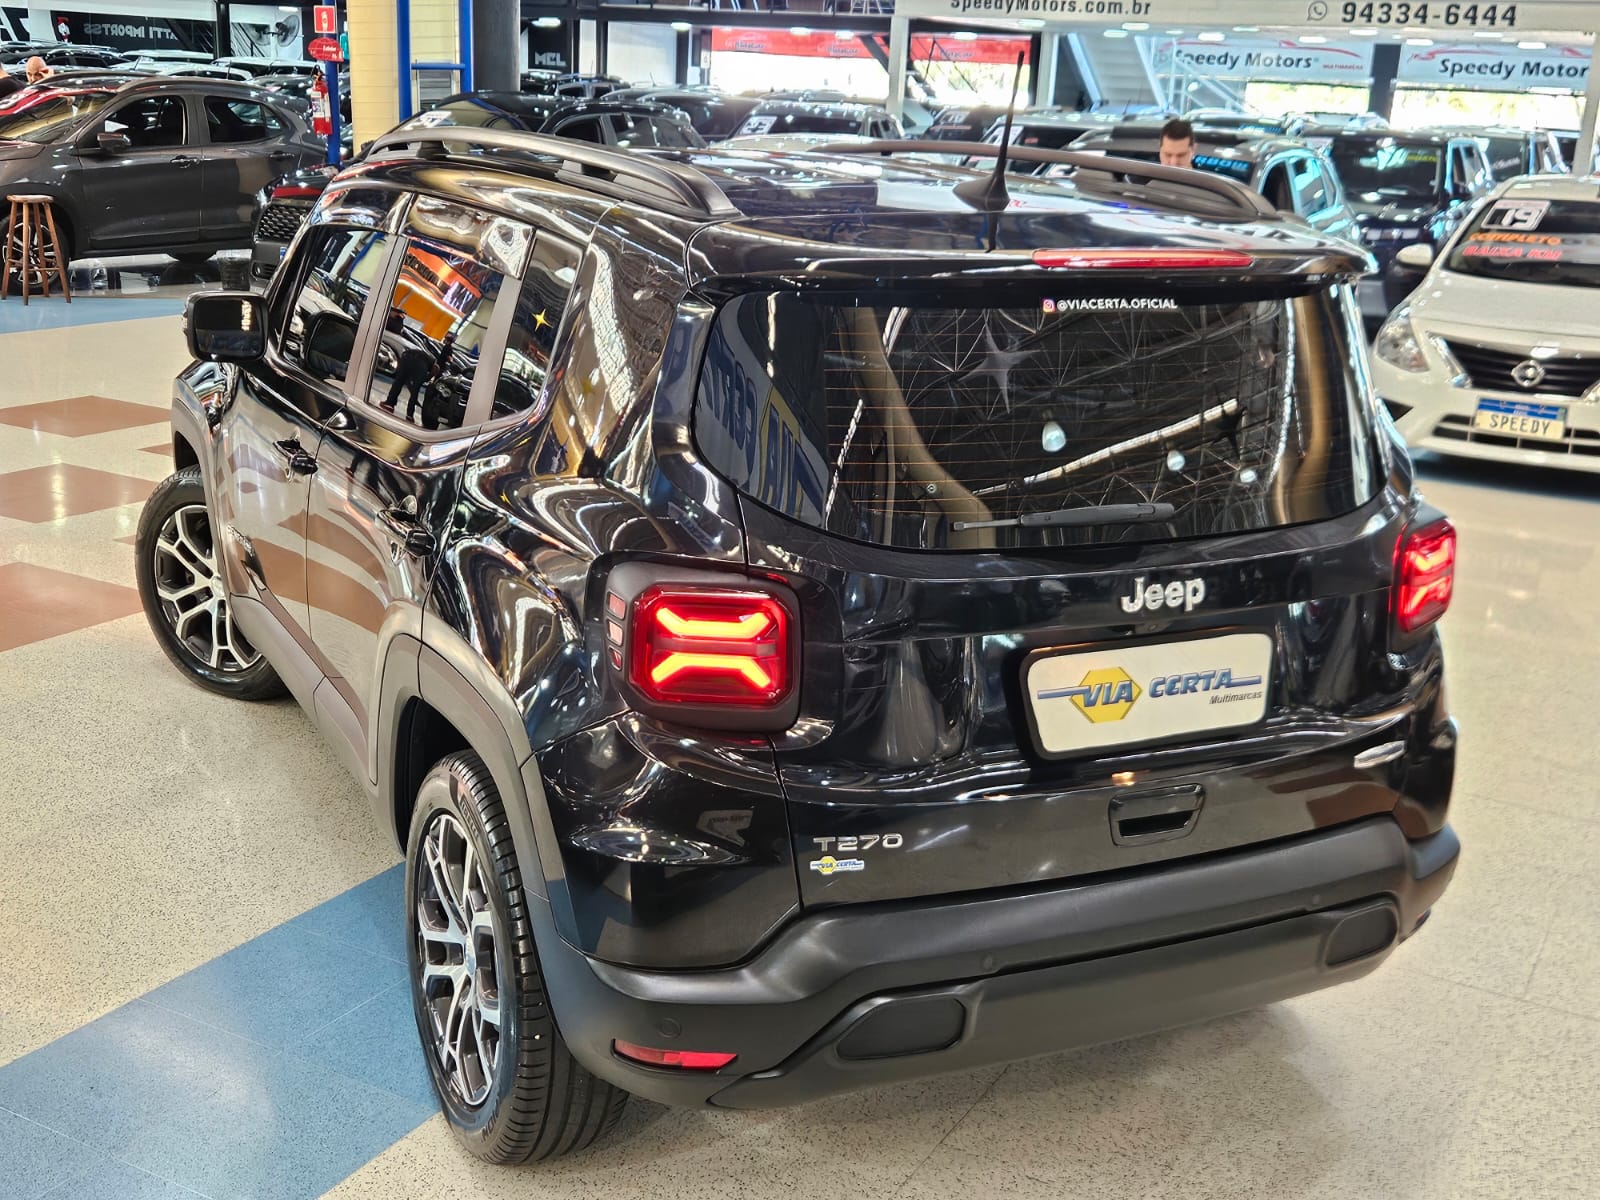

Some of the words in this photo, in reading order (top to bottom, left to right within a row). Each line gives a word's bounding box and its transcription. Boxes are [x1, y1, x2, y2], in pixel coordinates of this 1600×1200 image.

[1342, 2, 1517, 26] 94334-6444
[1244, 52, 1312, 69] Motors
[1439, 58, 1516, 80] Speedy
[1057, 299, 1178, 312] @VIACERTA.OFICIAL
[1490, 414, 1550, 434] SPEEDY
[1121, 577, 1205, 613] Jeep
[1082, 680, 1134, 708] VIA
[1149, 668, 1232, 698] CERTA
[1209, 690, 1262, 705] Multimarcas
[813, 834, 903, 852] T270
